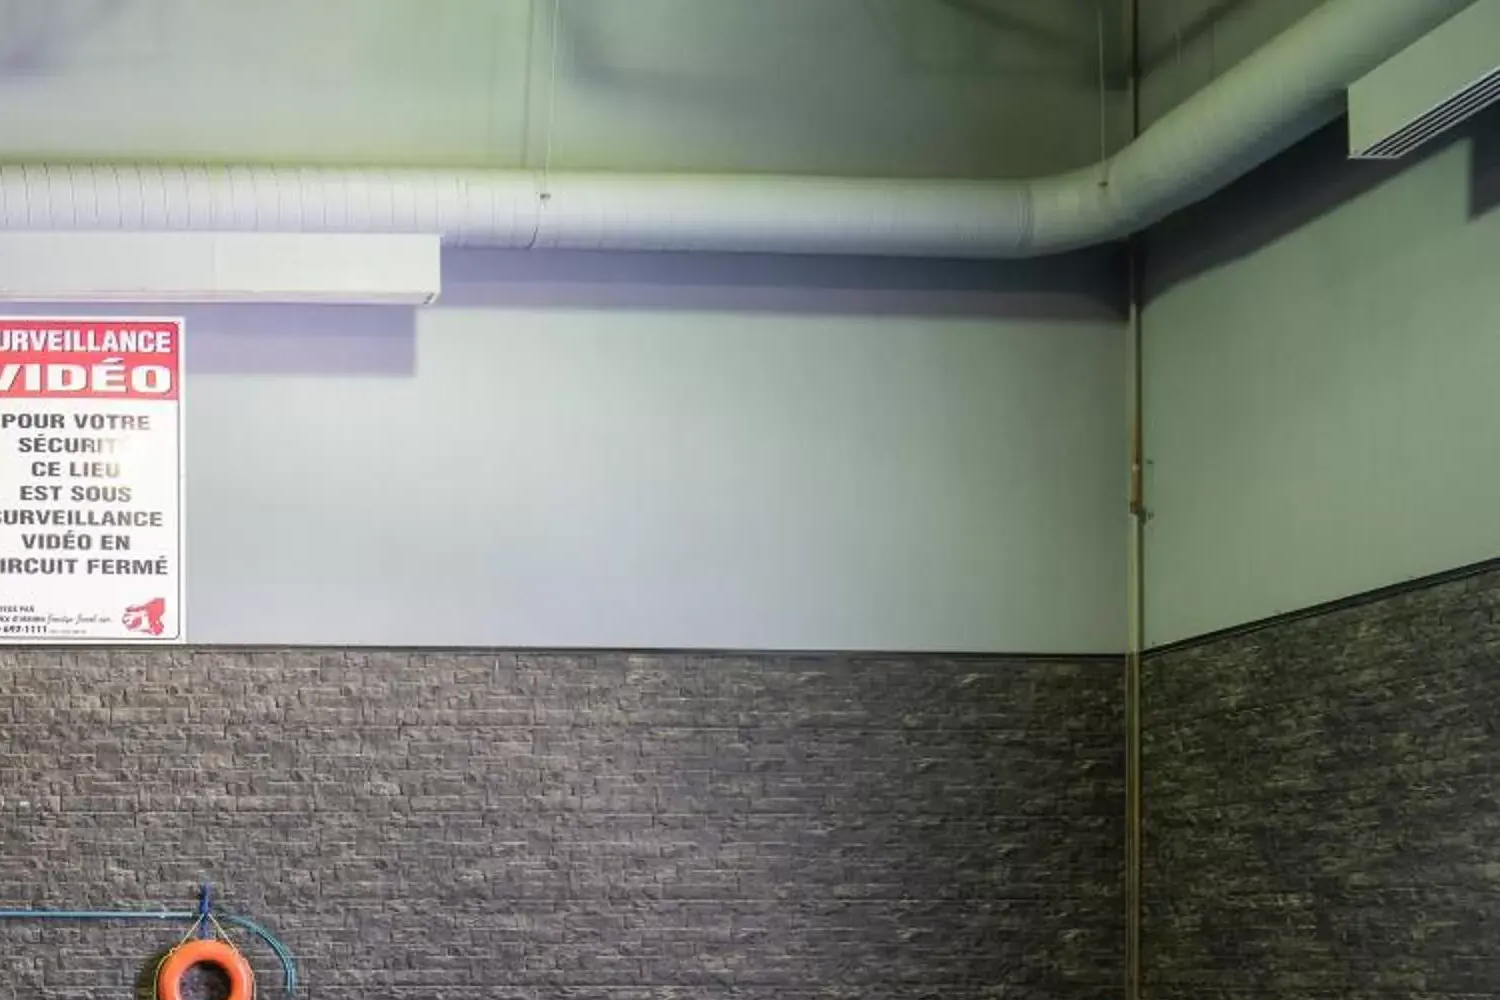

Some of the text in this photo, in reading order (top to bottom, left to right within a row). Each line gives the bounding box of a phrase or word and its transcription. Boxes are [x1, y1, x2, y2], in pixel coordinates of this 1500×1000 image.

[1, 413, 151, 430] POUR VOTRE
[18, 433, 125, 453] SÉCURIT
[31, 461, 120, 478] CE LIEU
[20, 485, 132, 502] EST SOUS
[22, 530, 131, 550] VIDÉO EN
[87, 555, 169, 575] FERMÉ
